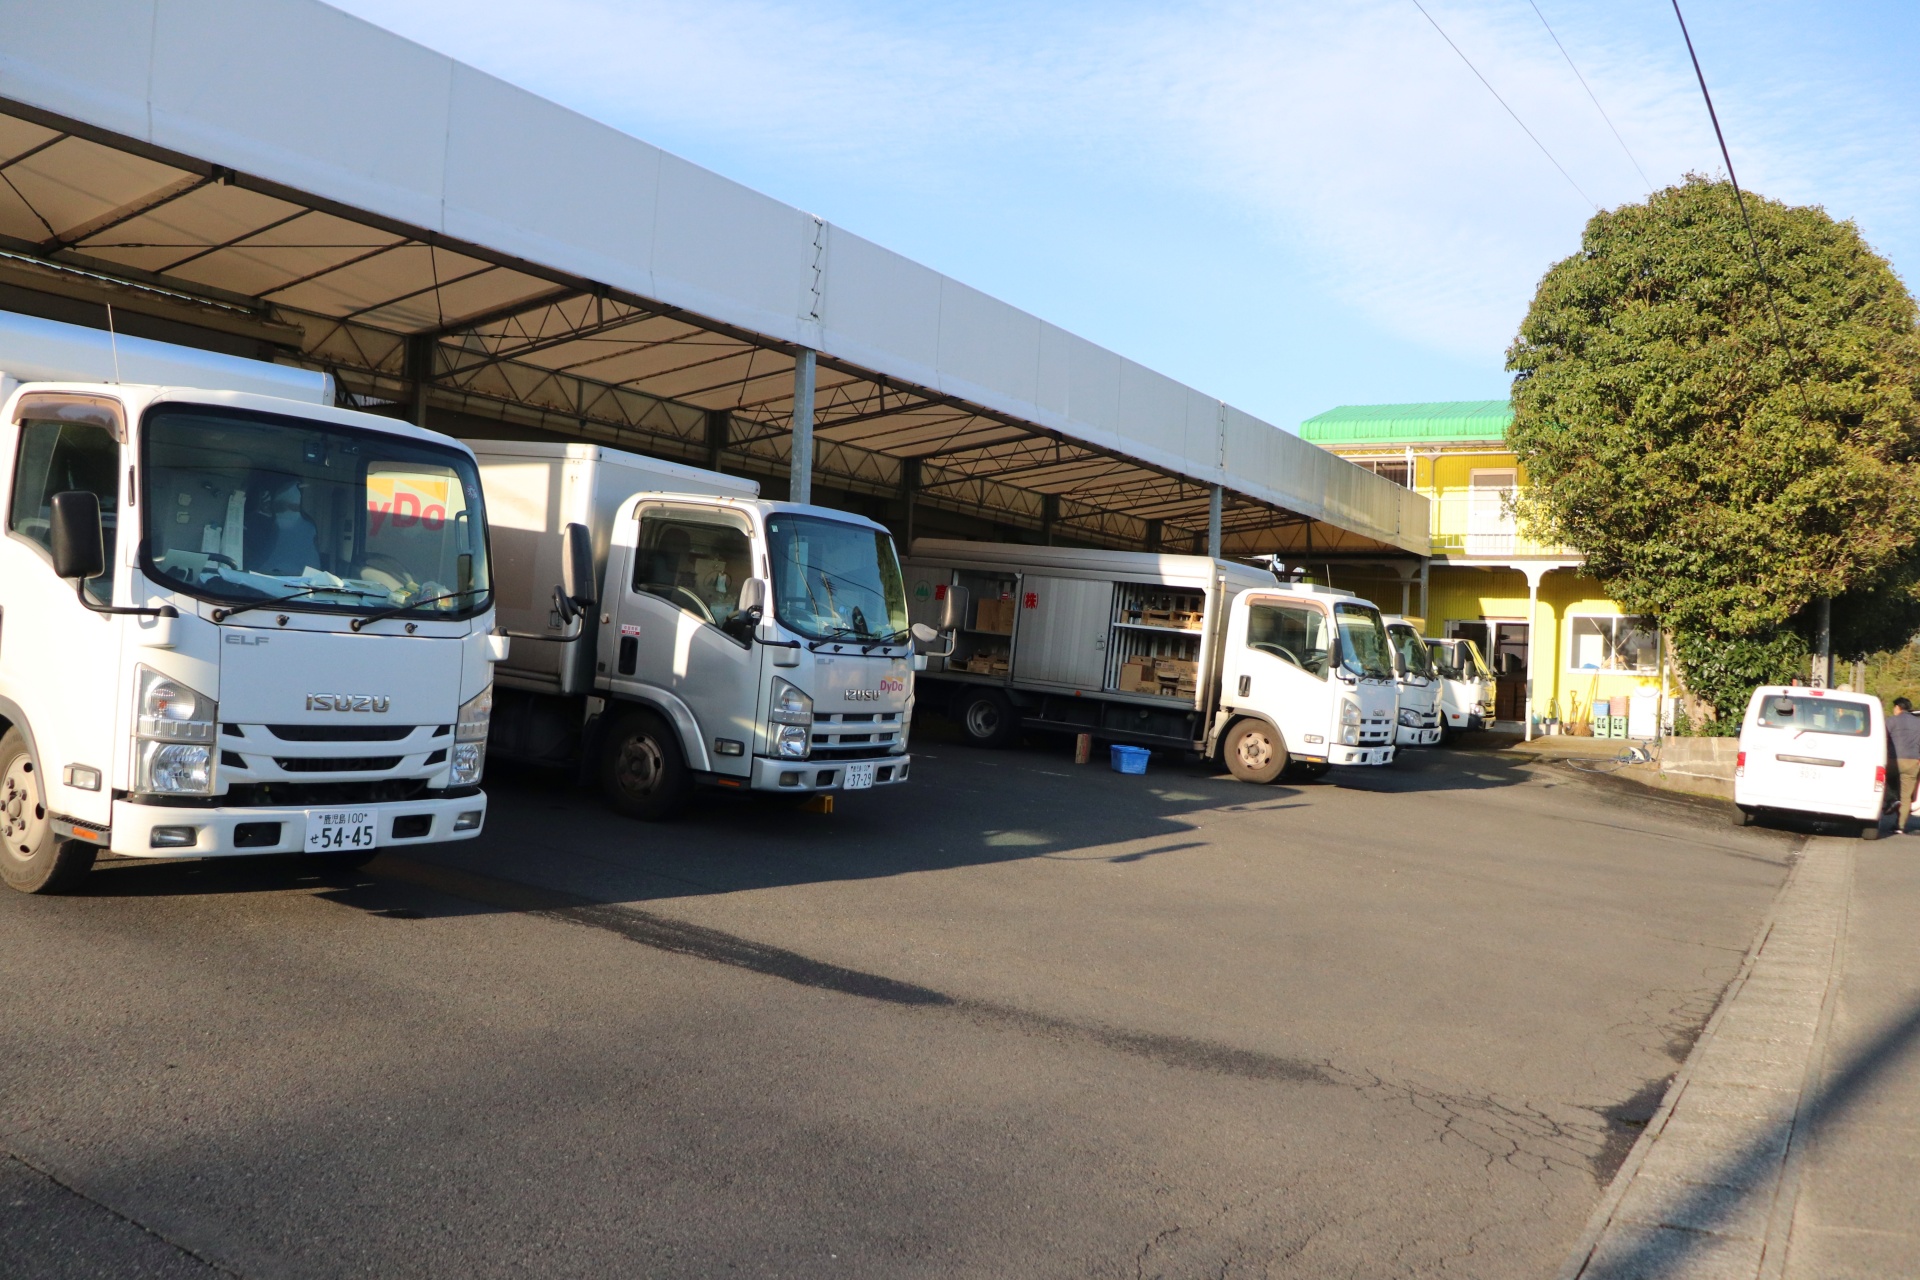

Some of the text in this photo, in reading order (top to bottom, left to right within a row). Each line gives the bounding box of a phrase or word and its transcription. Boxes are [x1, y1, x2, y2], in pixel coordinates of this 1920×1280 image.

[368, 492, 446, 537] yDo
[225, 634, 270, 646] ELF
[880, 680, 903, 694] DyDo
[305, 693, 390, 713] ISUZU
[851, 773, 872, 787] 37-29
[322, 826, 374, 848] 54-45
